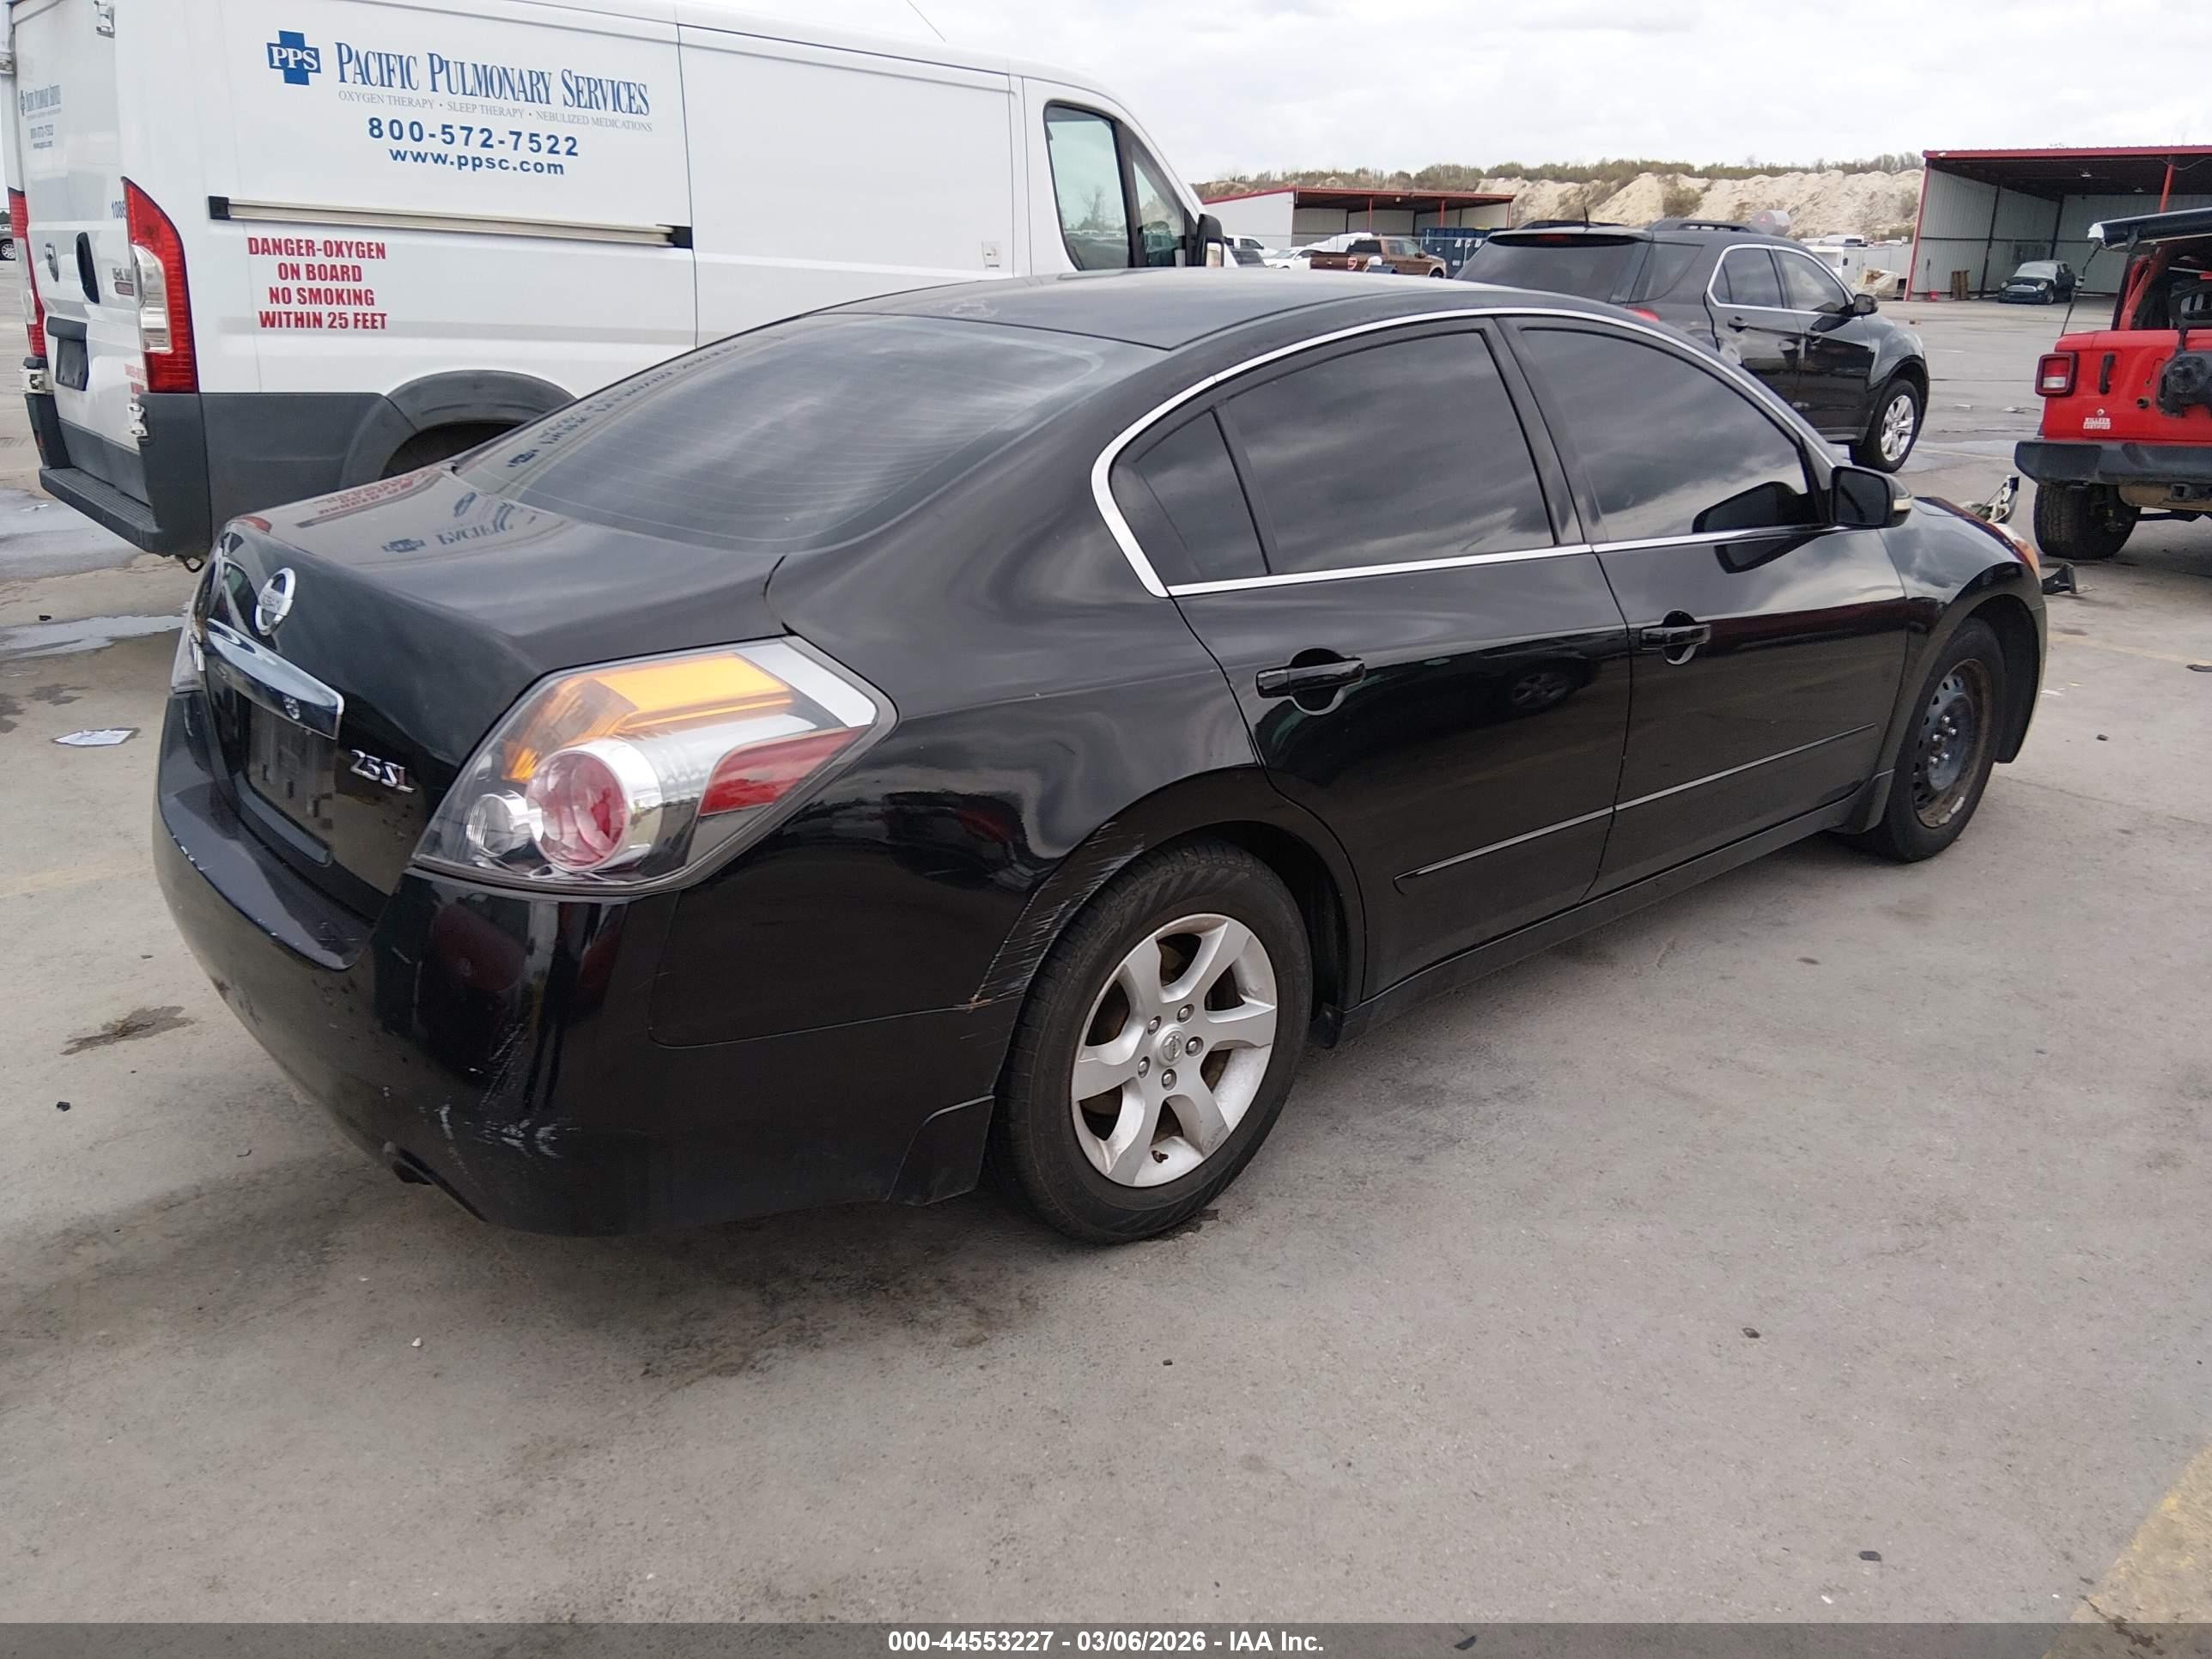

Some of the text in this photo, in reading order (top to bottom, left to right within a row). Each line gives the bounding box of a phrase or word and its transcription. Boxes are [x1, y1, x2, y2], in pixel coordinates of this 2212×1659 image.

[270, 46, 318, 70] PPS
[335, 42, 650, 116] PACIFIC PULMONARY SERVICES
[338, 90, 653, 132] OXYGEN THERAPY SLEEP THERAPY NEBULIZED MEDICATIONS
[368, 117, 579, 156] 800-572-7522
[389, 149, 564, 175] www.ppsc.com
[247, 237, 386, 259] DANGER-OXYGEN
[278, 263, 362, 282] ON BOARD
[269, 287, 374, 306] NO SMOKING
[258, 311, 387, 330] WITHIN 25 FEET
